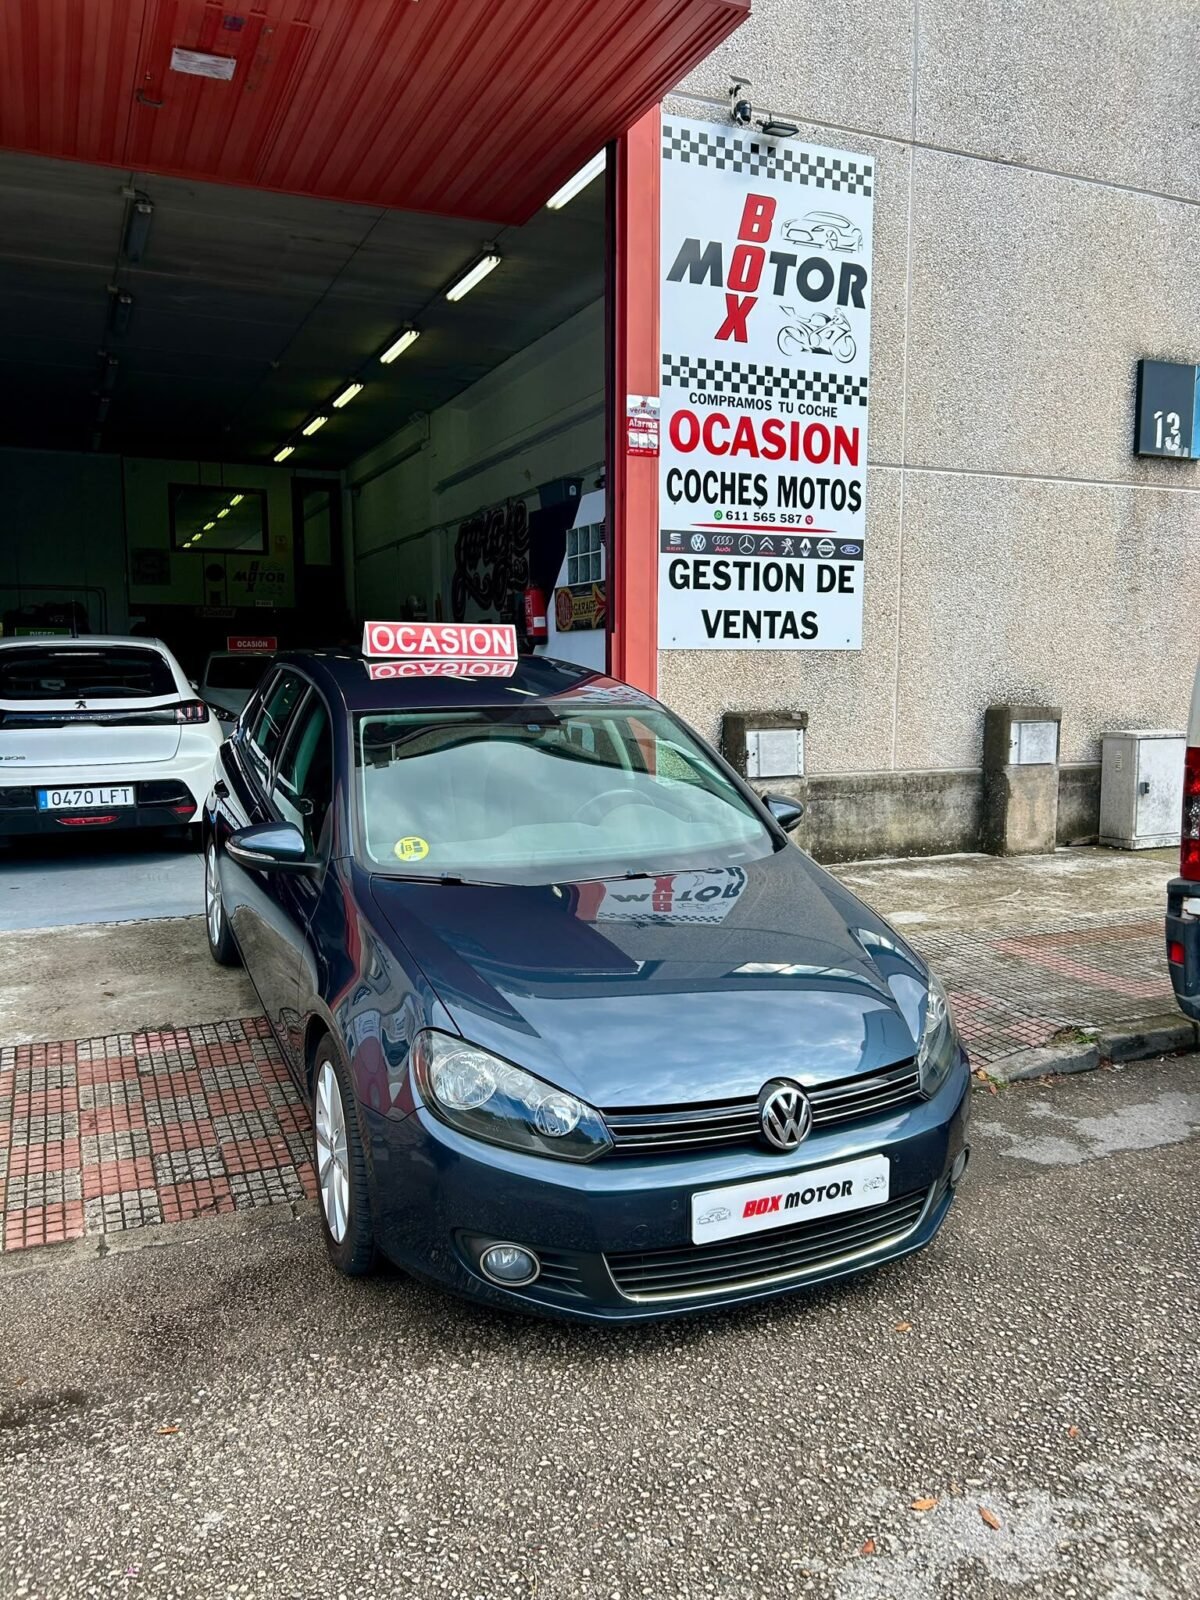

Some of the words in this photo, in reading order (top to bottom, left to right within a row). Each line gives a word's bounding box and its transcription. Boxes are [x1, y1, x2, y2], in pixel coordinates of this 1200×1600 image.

[666, 238, 868, 309] MOTOR
[715, 193, 776, 343] BOX
[689, 392, 772, 411] COMPRAMOS
[778, 401, 794, 413] TU
[799, 404, 838, 418] COCHE
[629, 418, 658, 429] Alarma
[669, 409, 859, 466] OCASION
[1154, 411, 1180, 450] 13
[666, 468, 768, 507] COCHES
[777, 475, 862, 513] MOTOS
[726, 510, 748, 521] 611
[753, 513, 776, 523] 565
[780, 514, 802, 524] 587
[668, 558, 805, 592] GESTION
[816, 564, 855, 593] DE
[371, 626, 511, 654] OCASION
[701, 609, 819, 640] VENTAS
[51, 789, 94, 806] 0470
[99, 787, 130, 804] LFT
[742, 1194, 783, 1218] BOX
[784, 1180, 853, 1209] MOTOR
